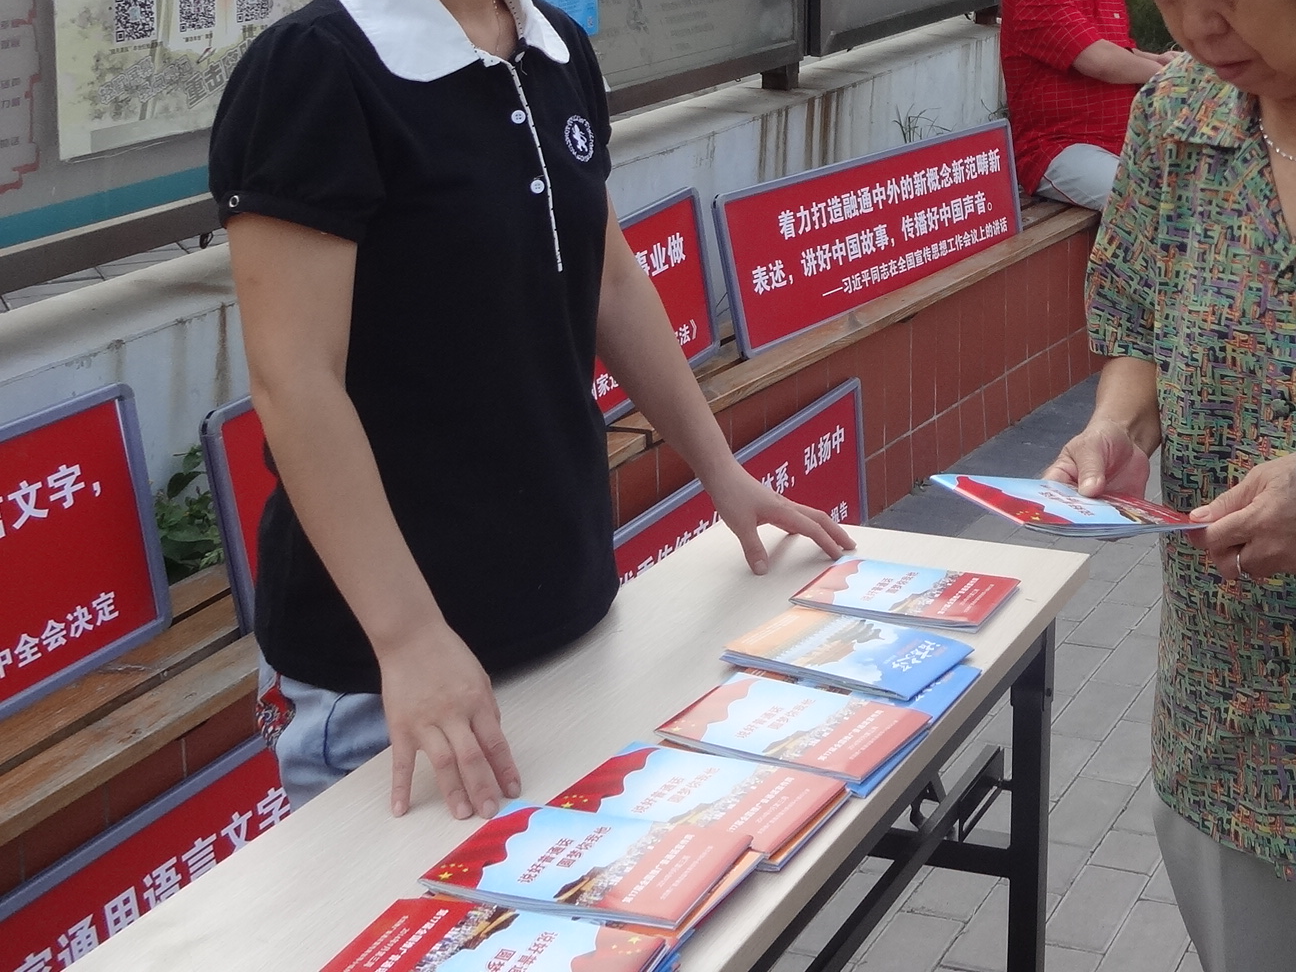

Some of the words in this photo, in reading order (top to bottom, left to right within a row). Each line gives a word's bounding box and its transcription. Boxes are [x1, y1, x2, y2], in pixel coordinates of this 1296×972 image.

[778, 149, 1001, 240] 着力打造融通中外的新概念新范畴新
[0, 464, 101, 539] 文字，
